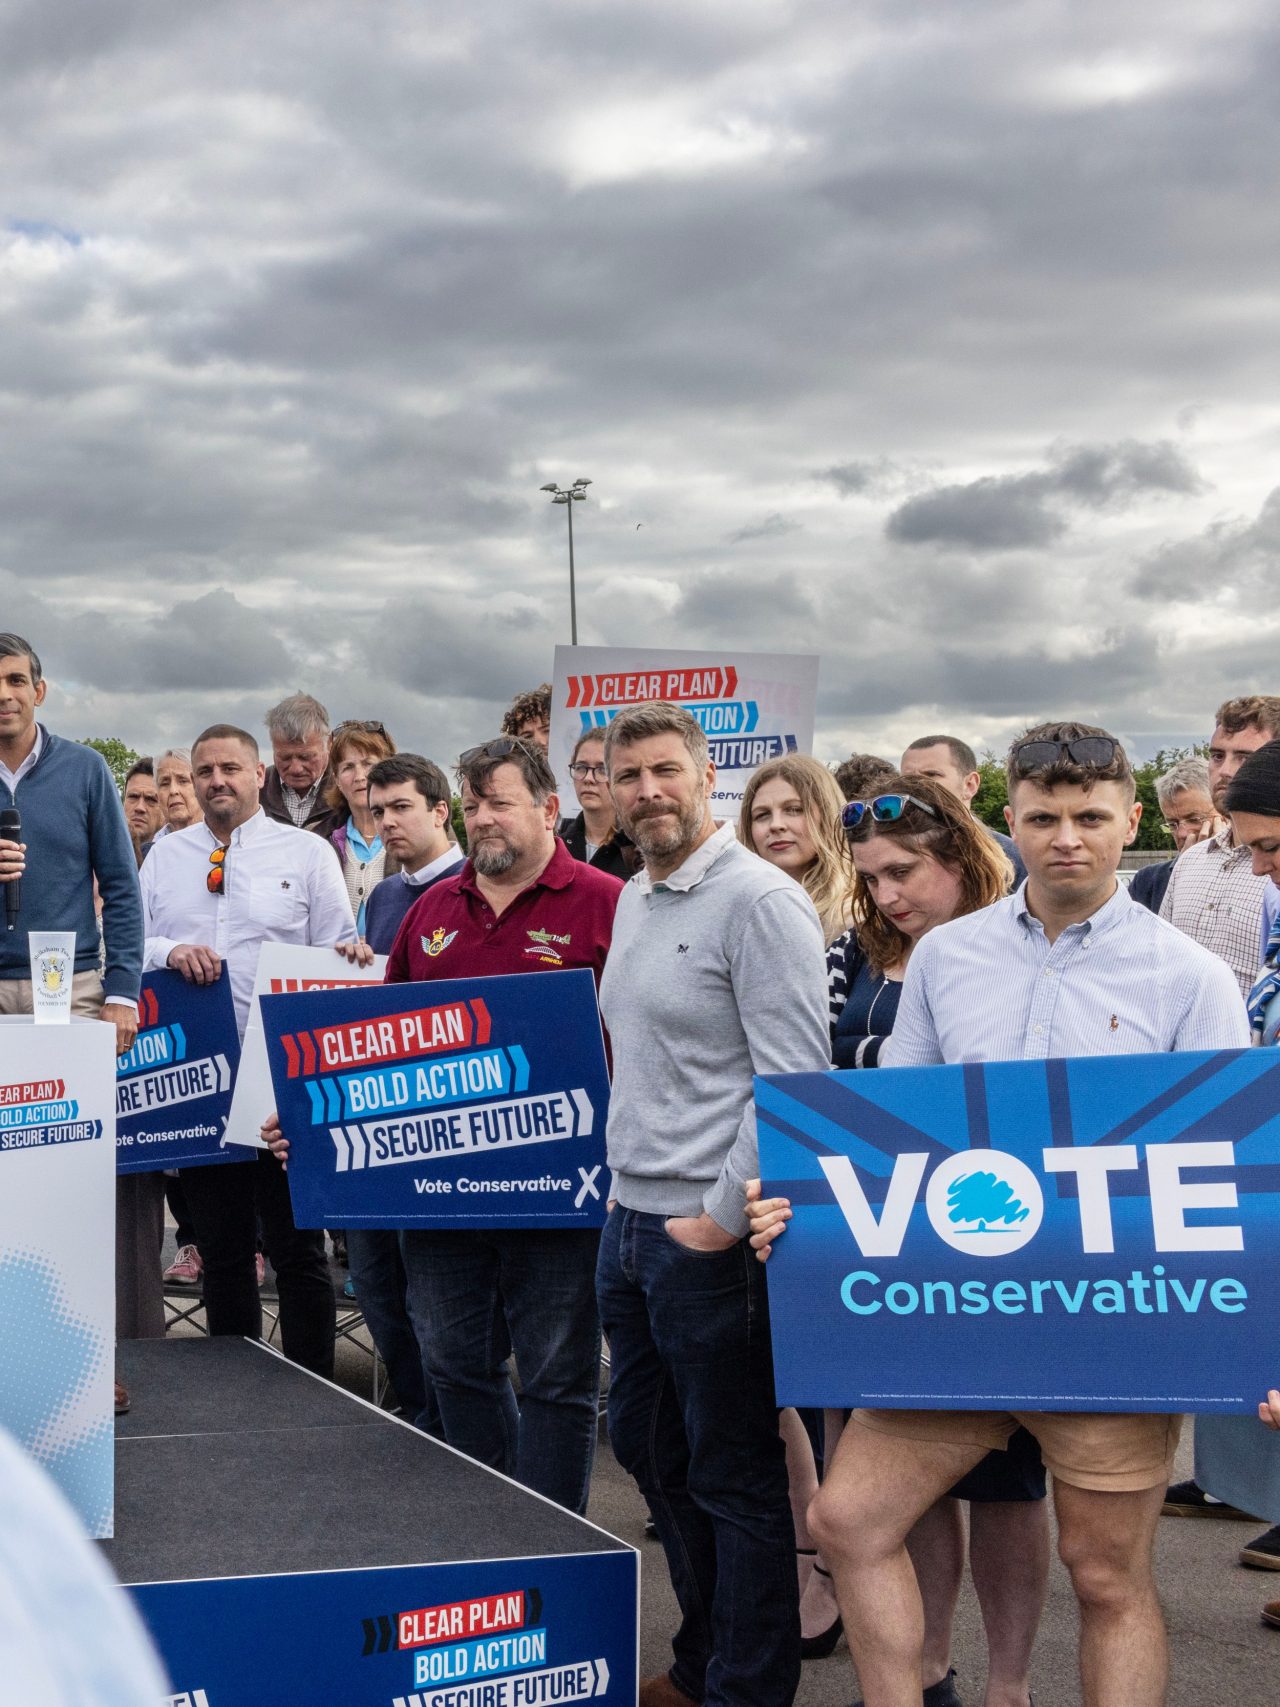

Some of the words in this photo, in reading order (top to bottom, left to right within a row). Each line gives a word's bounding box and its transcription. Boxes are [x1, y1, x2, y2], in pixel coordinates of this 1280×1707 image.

[601, 676, 661, 702] CLEAR
[666, 670, 717, 697] PLAN
[687, 705, 738, 731] TION
[116, 1032, 169, 1072] TION
[322, 1020, 398, 1066] CLEAR
[400, 1007, 465, 1052] PLAN
[23, 1082, 53, 1101] PLAN
[144, 1063, 213, 1106] FUTURE
[347, 1071, 409, 1113] BOLD
[415, 1054, 503, 1102] ACTION
[25, 1103, 67, 1124] ACTION
[373, 1114, 465, 1160] SECURE
[468, 1098, 567, 1147] FUTURE
[1, 1128, 46, 1149] SECURE
[47, 1122, 91, 1143] FUTURE
[116, 1132, 134, 1147] ote
[136, 1123, 218, 1145] Conservative
[413, 1178, 452, 1194] Vote
[456, 1174, 572, 1193] Conservative
[817, 1140, 1245, 1258] VOTE
[839, 1264, 1249, 1317] Conservative
[399, 1606, 464, 1645] CLEAR
[469, 1595, 521, 1634] PLAN
[416, 1647, 468, 1684] BOLD
[473, 1632, 546, 1674] ACTION
[513, 1666, 589, 1707] FUTURE
